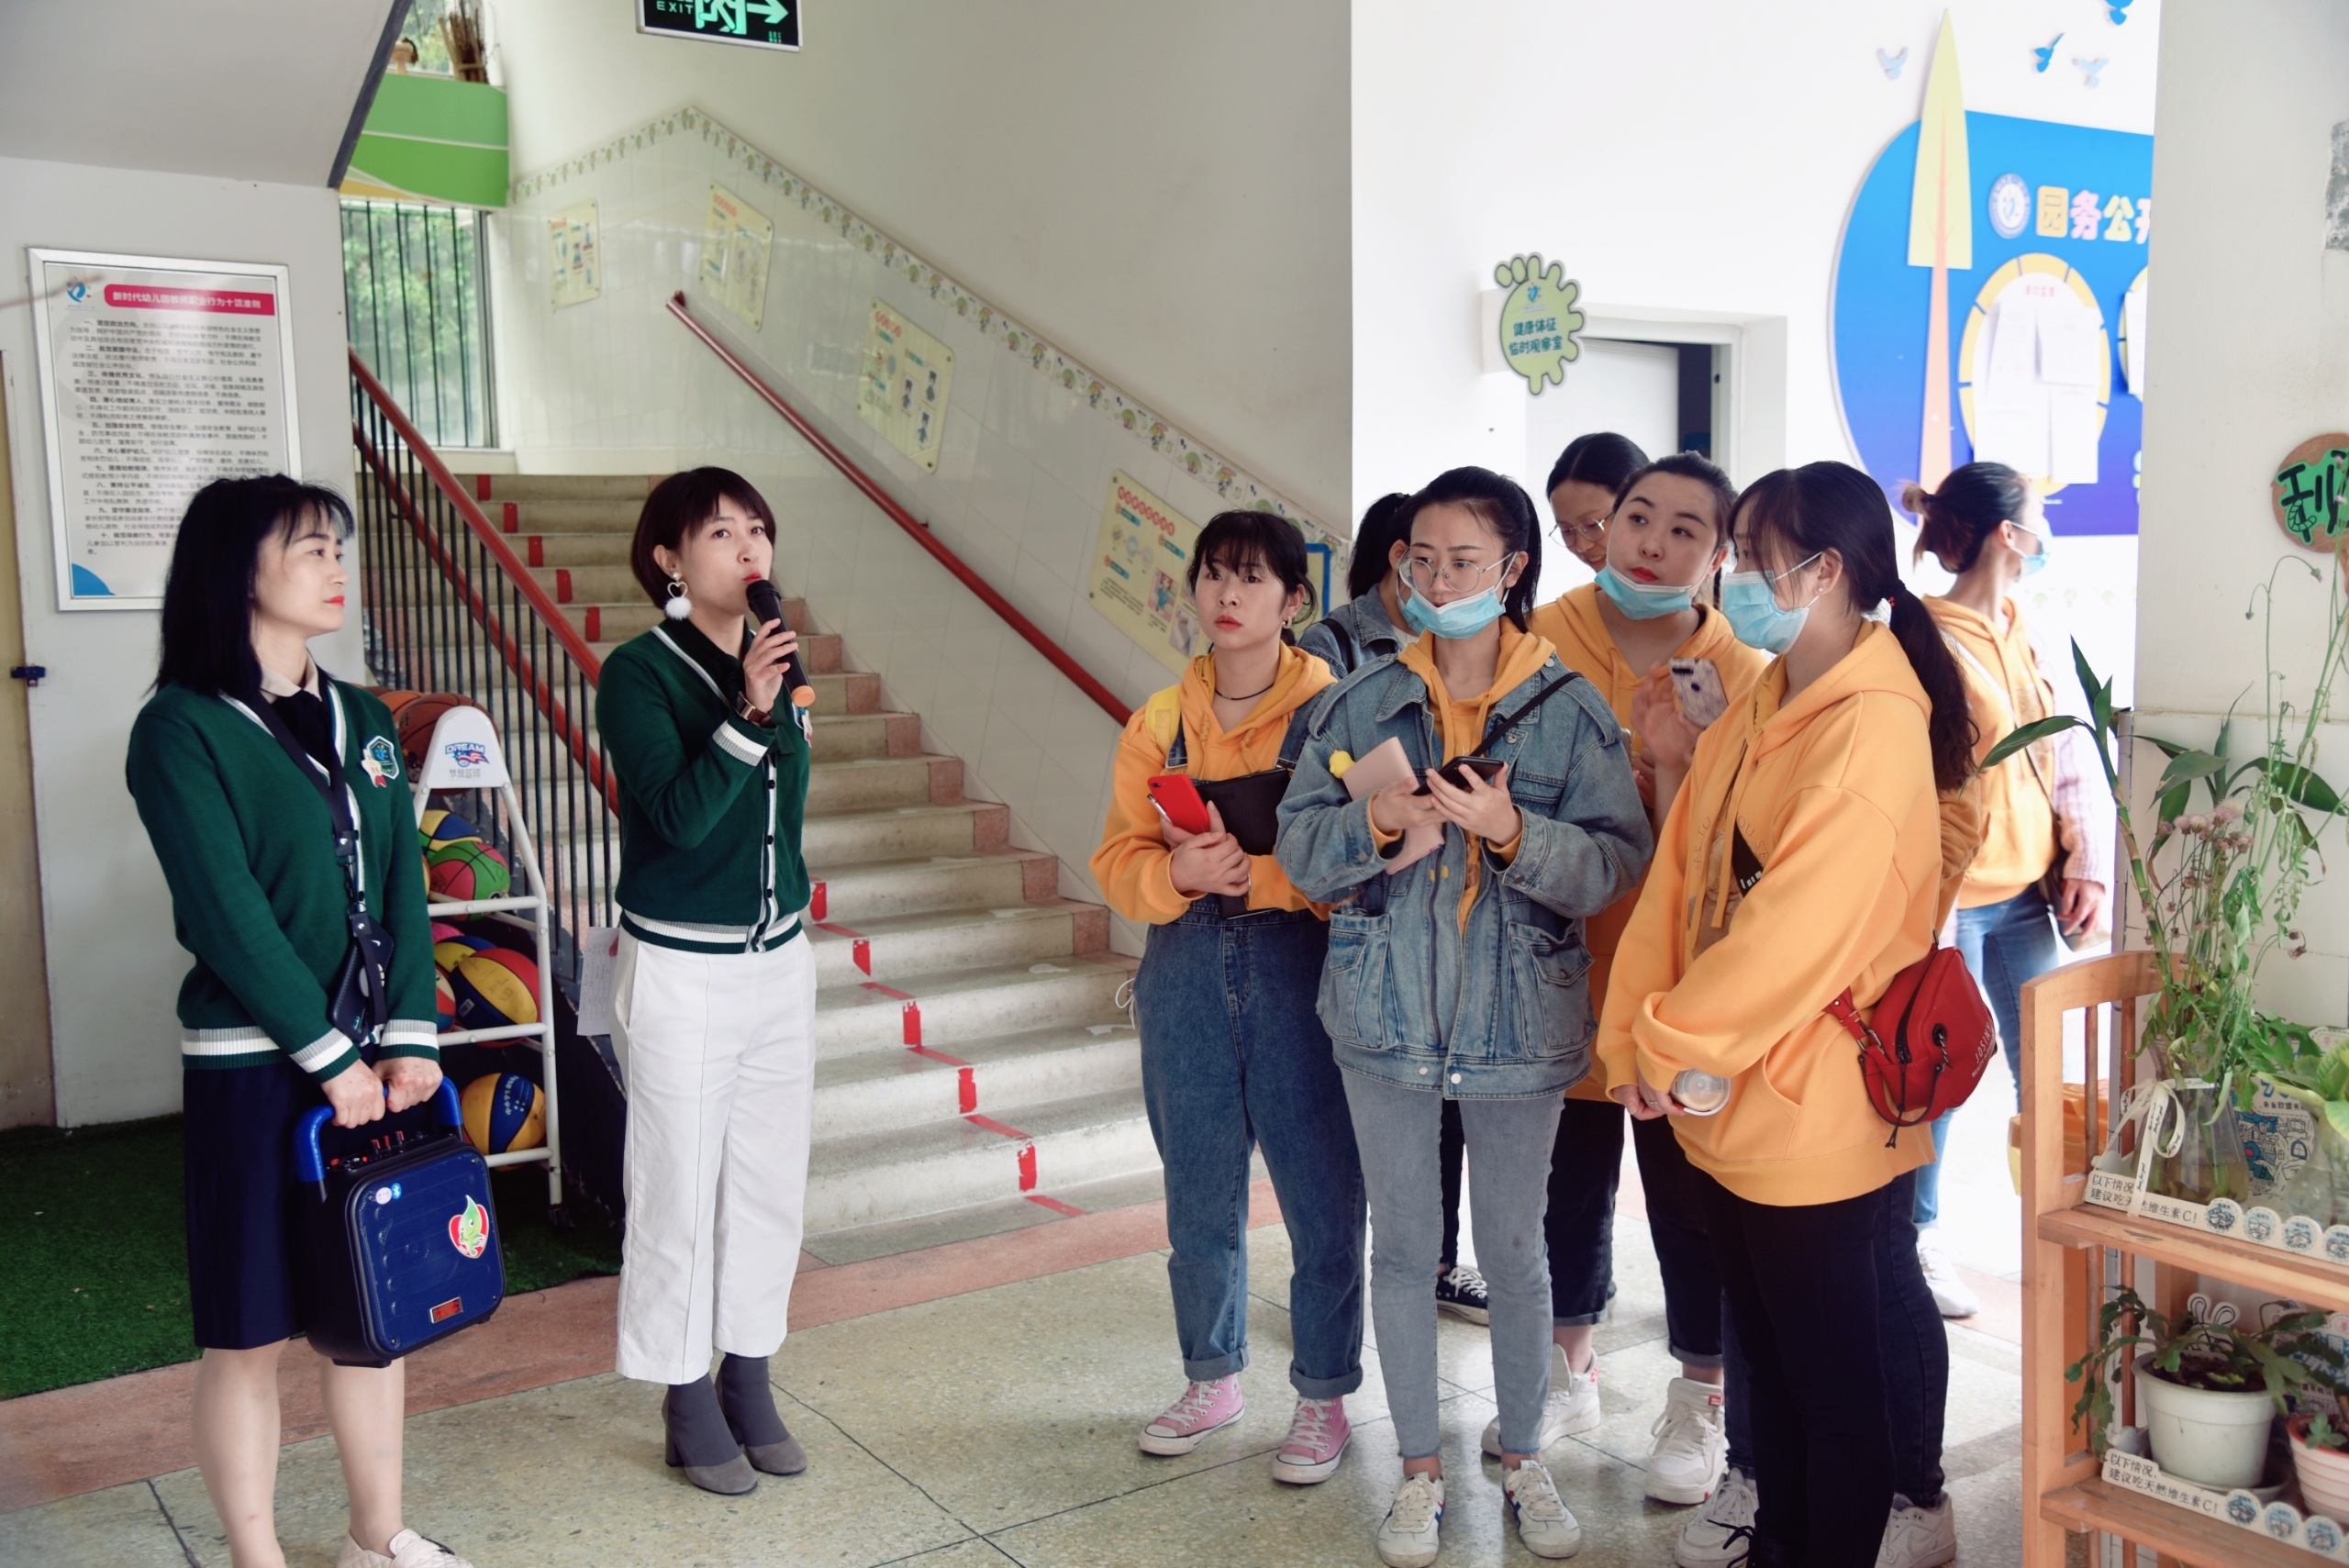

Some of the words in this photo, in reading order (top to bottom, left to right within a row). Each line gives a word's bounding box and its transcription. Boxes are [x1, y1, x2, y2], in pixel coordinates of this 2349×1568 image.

[656, 0, 694, 15] EXIT
[1513, 317, 1557, 337] 健康体征
[1508, 335, 1563, 356] 临时观察室
[445, 742, 485, 754] DREAM
[1975, 1021, 1992, 1064] JOSINY
